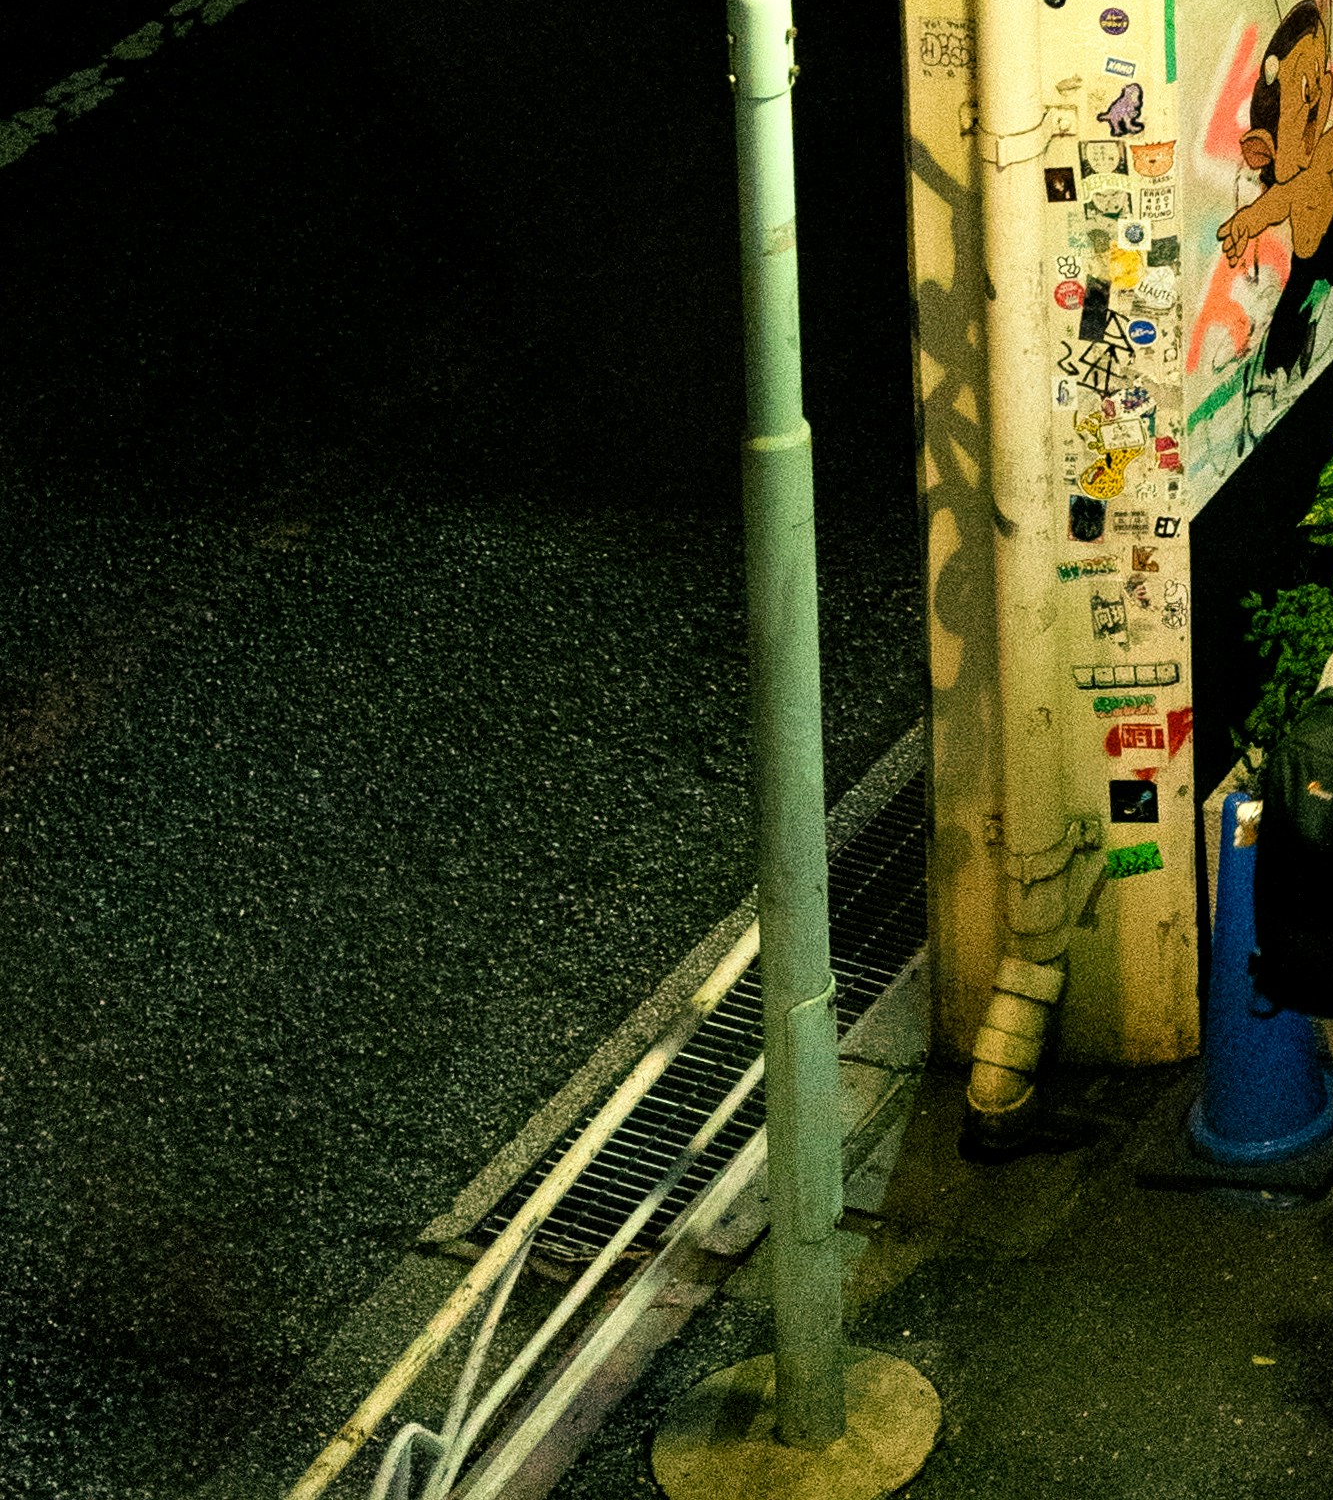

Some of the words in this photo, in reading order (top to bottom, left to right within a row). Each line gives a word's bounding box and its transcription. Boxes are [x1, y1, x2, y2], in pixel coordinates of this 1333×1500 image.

[1143, 188, 1172, 197] ERROR
[1142, 209, 1172, 219] FOUND
[1138, 280, 1172, 301] HAUTE
